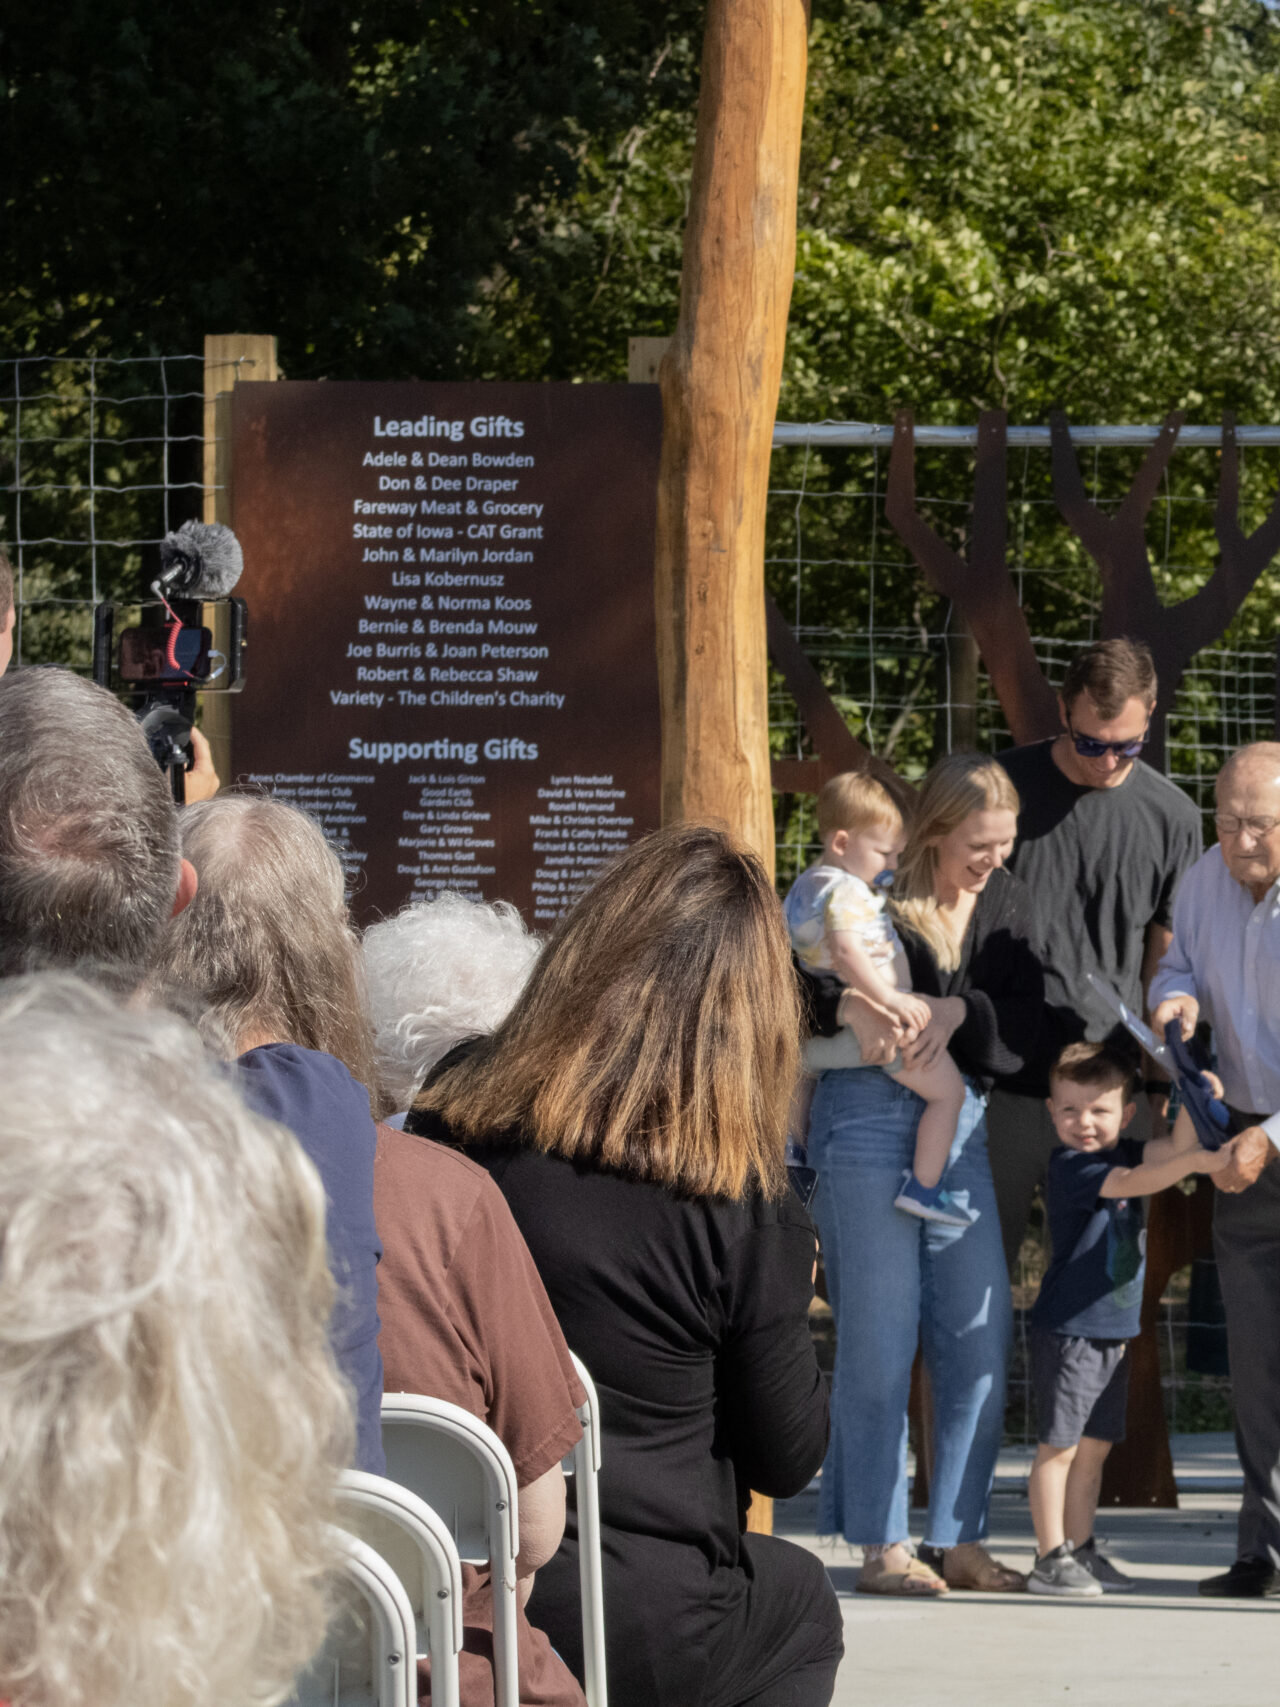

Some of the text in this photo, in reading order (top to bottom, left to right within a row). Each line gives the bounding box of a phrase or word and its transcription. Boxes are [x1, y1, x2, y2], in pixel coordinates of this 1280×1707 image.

[374, 415, 524, 442] Leading Gifts
[362, 451, 534, 467] Adele & Dean Bowden
[378, 475, 519, 494] Don & Dee Draper
[353, 499, 544, 518] Fareway Meat & Grocery
[352, 522, 393, 539] State
[396, 523, 413, 539] of
[416, 524, 454, 539] Iowa
[467, 524, 497, 539] CAT
[499, 524, 543, 539] Grant
[361, 546, 534, 566] John & Marilyn Jordan
[392, 571, 504, 587] Lisa Kobernusz
[364, 594, 532, 613] Wayne & Norma Koos
[358, 618, 538, 635] Bernie & Brenda Mouw
[346, 642, 549, 659] Joe Burris & Joan Peterson
[357, 666, 539, 682] Robert & Rebecca Shaw
[330, 690, 385, 708] Variety
[397, 690, 427, 706] The
[430, 690, 507, 706] Children's
[509, 690, 565, 709] Charity
[349, 737, 539, 765] Supporting Gifts
